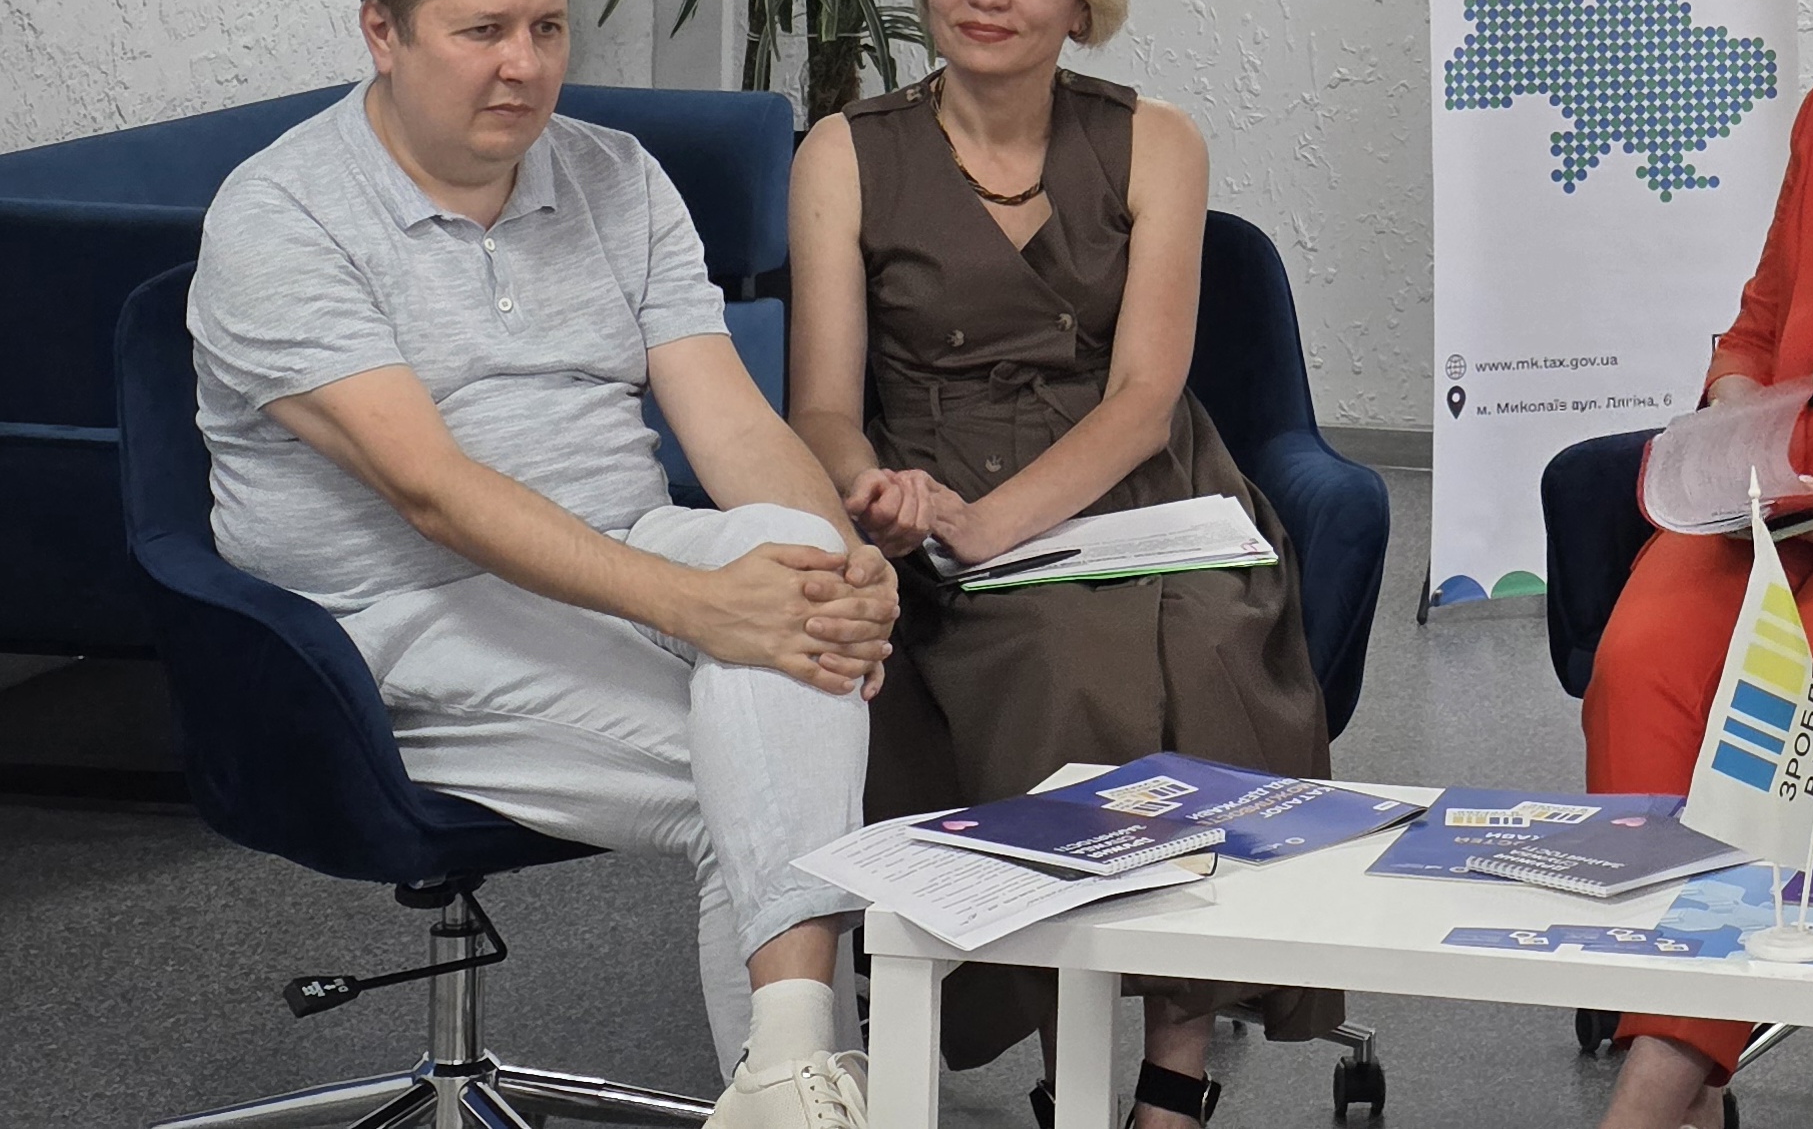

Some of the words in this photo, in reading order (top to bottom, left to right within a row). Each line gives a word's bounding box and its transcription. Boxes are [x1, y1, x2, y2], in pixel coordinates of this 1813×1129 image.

[1475, 354, 1618, 373] www.mk.tax.gov.ua
[1496, 398, 1566, 414] Миколаїв
[1663, 393, 1672, 406] 6
